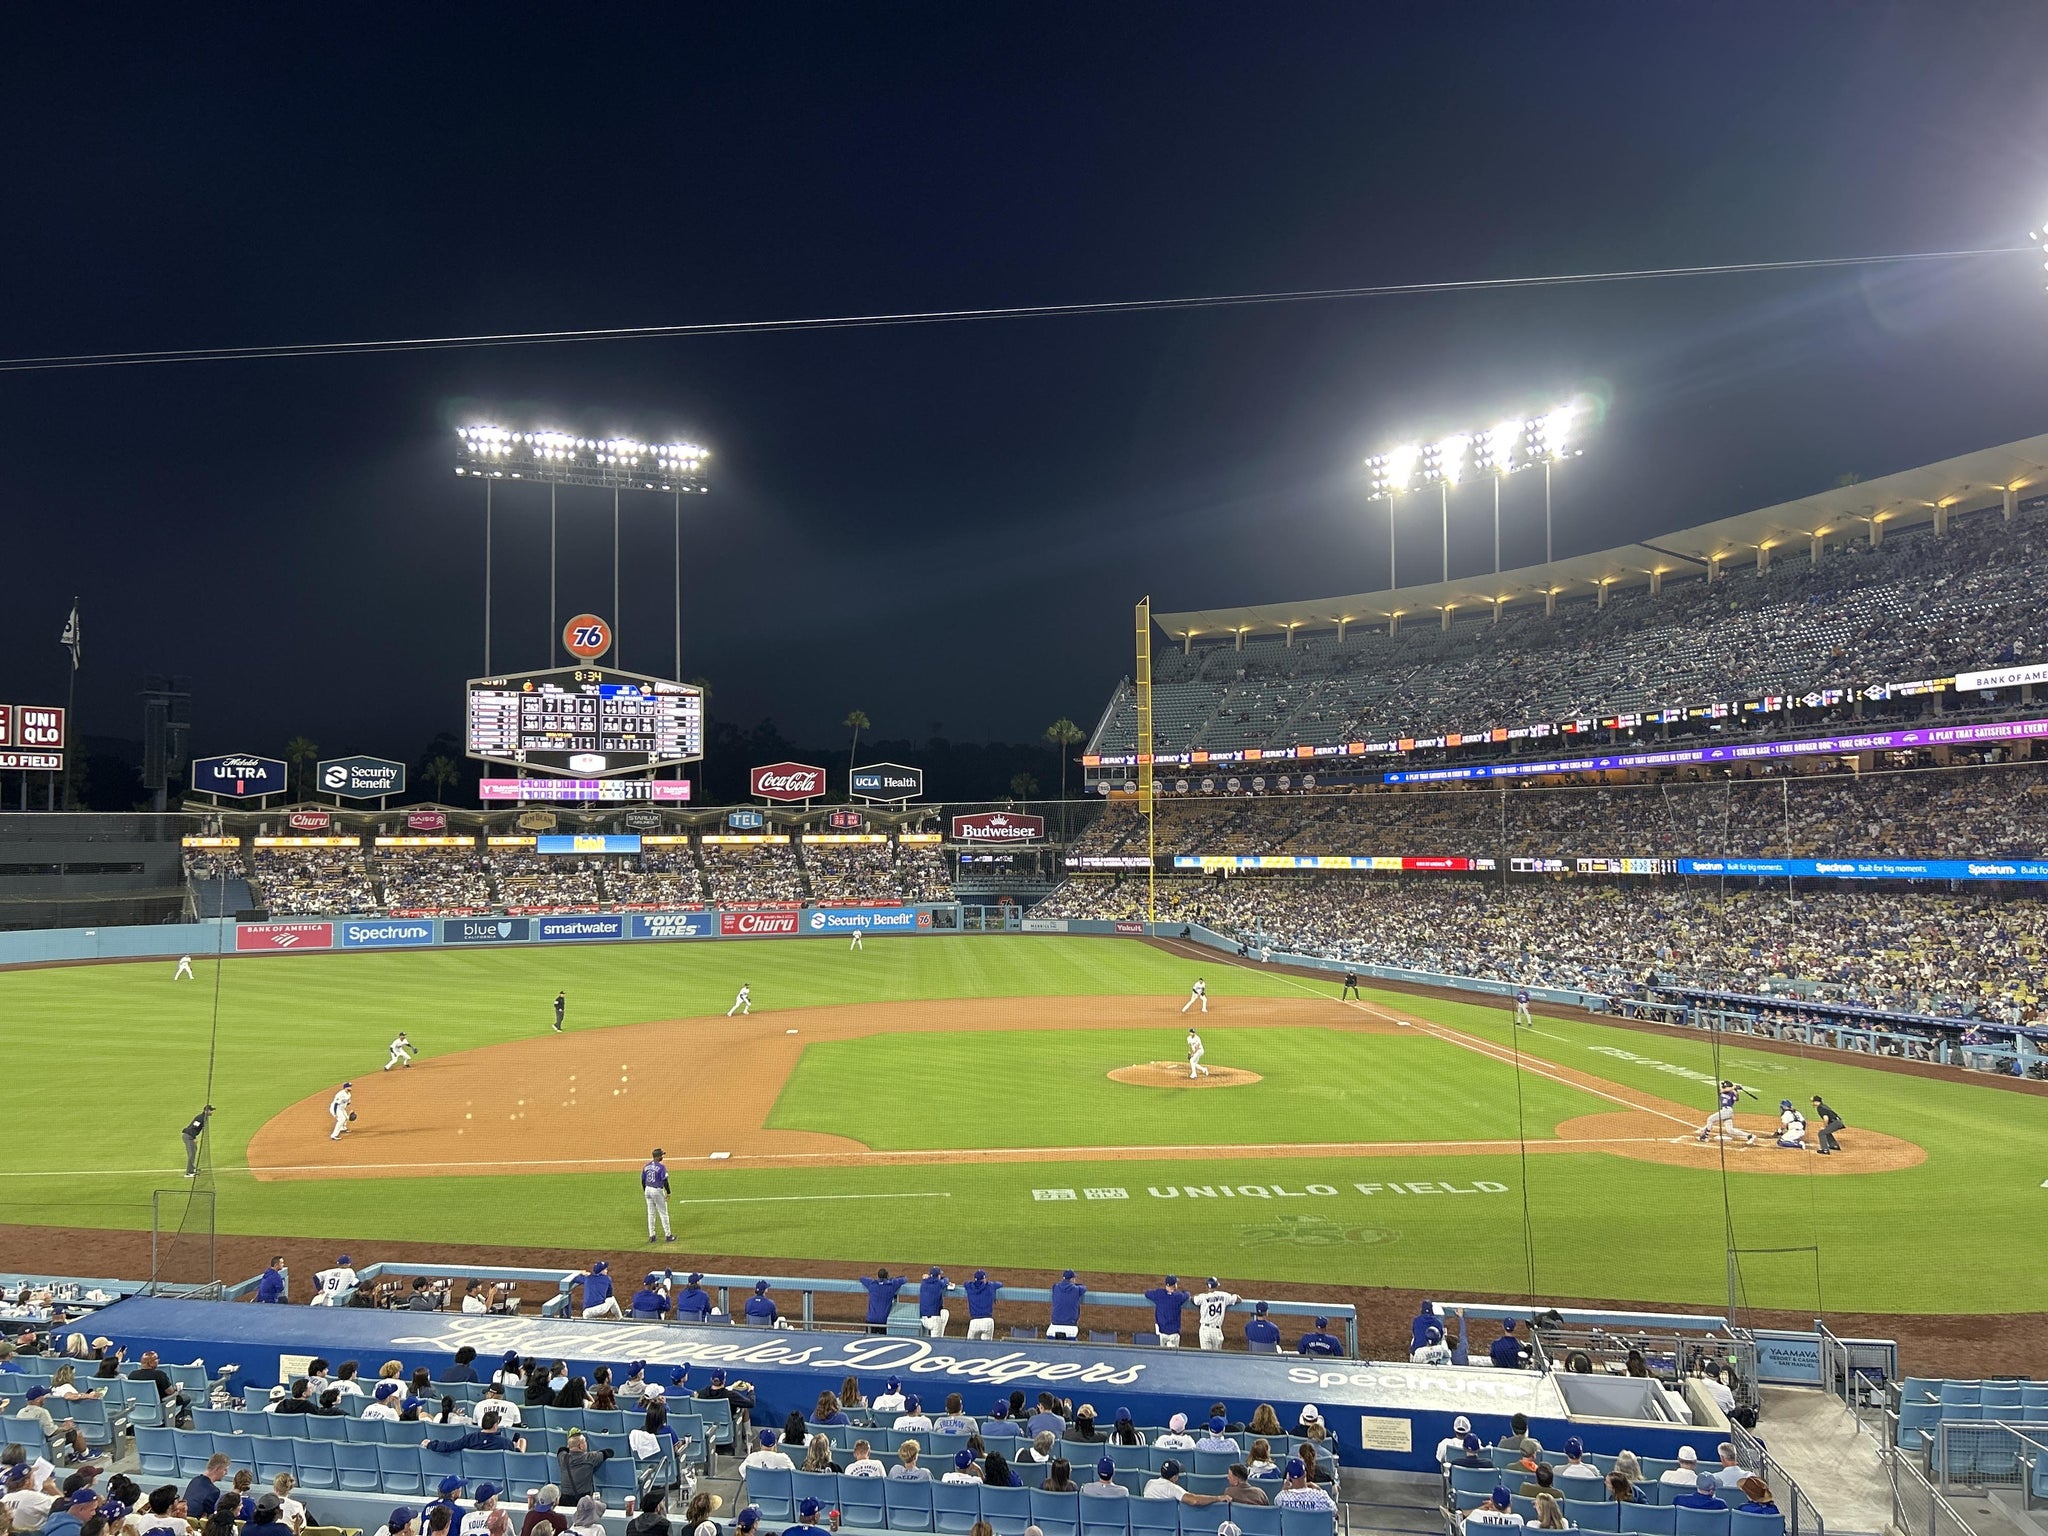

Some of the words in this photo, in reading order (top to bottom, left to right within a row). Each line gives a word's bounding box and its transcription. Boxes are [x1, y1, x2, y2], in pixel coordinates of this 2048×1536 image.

[572, 626, 602, 647] 76
[575, 671, 602, 681] 8:34
[1976, 677, 2007, 685] BANK
[2009, 675, 2021, 683] OF
[25, 712, 55, 727] UNI
[24, 728, 58, 745] QLO
[1935, 731, 1954, 740] PLAY
[1955, 729, 1973, 739] THAT
[1974, 726, 2011, 738] SATISFIES
[2023, 723, 2048, 734] EVERY
[1365, 743, 1389, 751] JERKY
[1415, 740, 1437, 748] JERKY
[1261, 750, 1286, 758] JERKY
[1314, 747, 1338, 755] JERKY
[20, 755, 58, 767] FIELD
[223, 758, 259, 767] Michelob
[214, 767, 268, 779] ULTRA
[351, 766, 398, 780] Security
[351, 778, 392, 789] Benefit
[758, 772, 818, 792] Coca-Cola
[856, 777, 879, 788] UCLA
[884, 777, 917, 788] Health
[626, 787, 634, 799] 2
[636, 787, 642, 799] 1
[645, 787, 651, 799] 1
[292, 815, 328, 826] Churu
[522, 816, 533, 826] JIM
[628, 814, 660, 822] STARLUX
[733, 815, 759, 826] TEL
[962, 824, 1035, 837] Budweiser
[1692, 861, 1722, 871] Spectrum
[1727, 862, 1738, 870] Built
[1747, 863, 1758, 872] big
[1816, 863, 1853, 874] Spectrum
[1858, 864, 1872, 872] Built
[1873, 864, 1883, 872] for
[1883, 864, 1895, 873] big
[1968, 863, 2012, 876] Spectrum
[2021, 865, 2039, 874] Built
[644, 914, 687, 926] TOYO
[738, 914, 795, 932] Churu
[828, 913, 872, 927] Security
[874, 912, 913, 925] Benefit
[919, 915, 930, 923] 76
[284, 924, 323, 932] AMERICA
[464, 923, 497, 935] blue
[543, 921, 618, 936] smartwater
[650, 924, 697, 936] TIRES
[1117, 923, 1143, 932] Yakult
[348, 925, 424, 943] Spectrum
[1147, 1184, 1339, 1199] UNIQLO
[1354, 1181, 1509, 1195] FIELD
[329, 1278, 340, 1291] 91
[1208, 1303, 1222, 1317] 84
[391, 1317, 531, 1351] Los
[523, 1323, 822, 1367] Angeles
[809, 1337, 1146, 1385] Dodgers
[1287, 1367, 1505, 1398] Spectrum
[483, 1406, 508, 1414] OHTANI
[1281, 1499, 1316, 1509] FREEMAN
